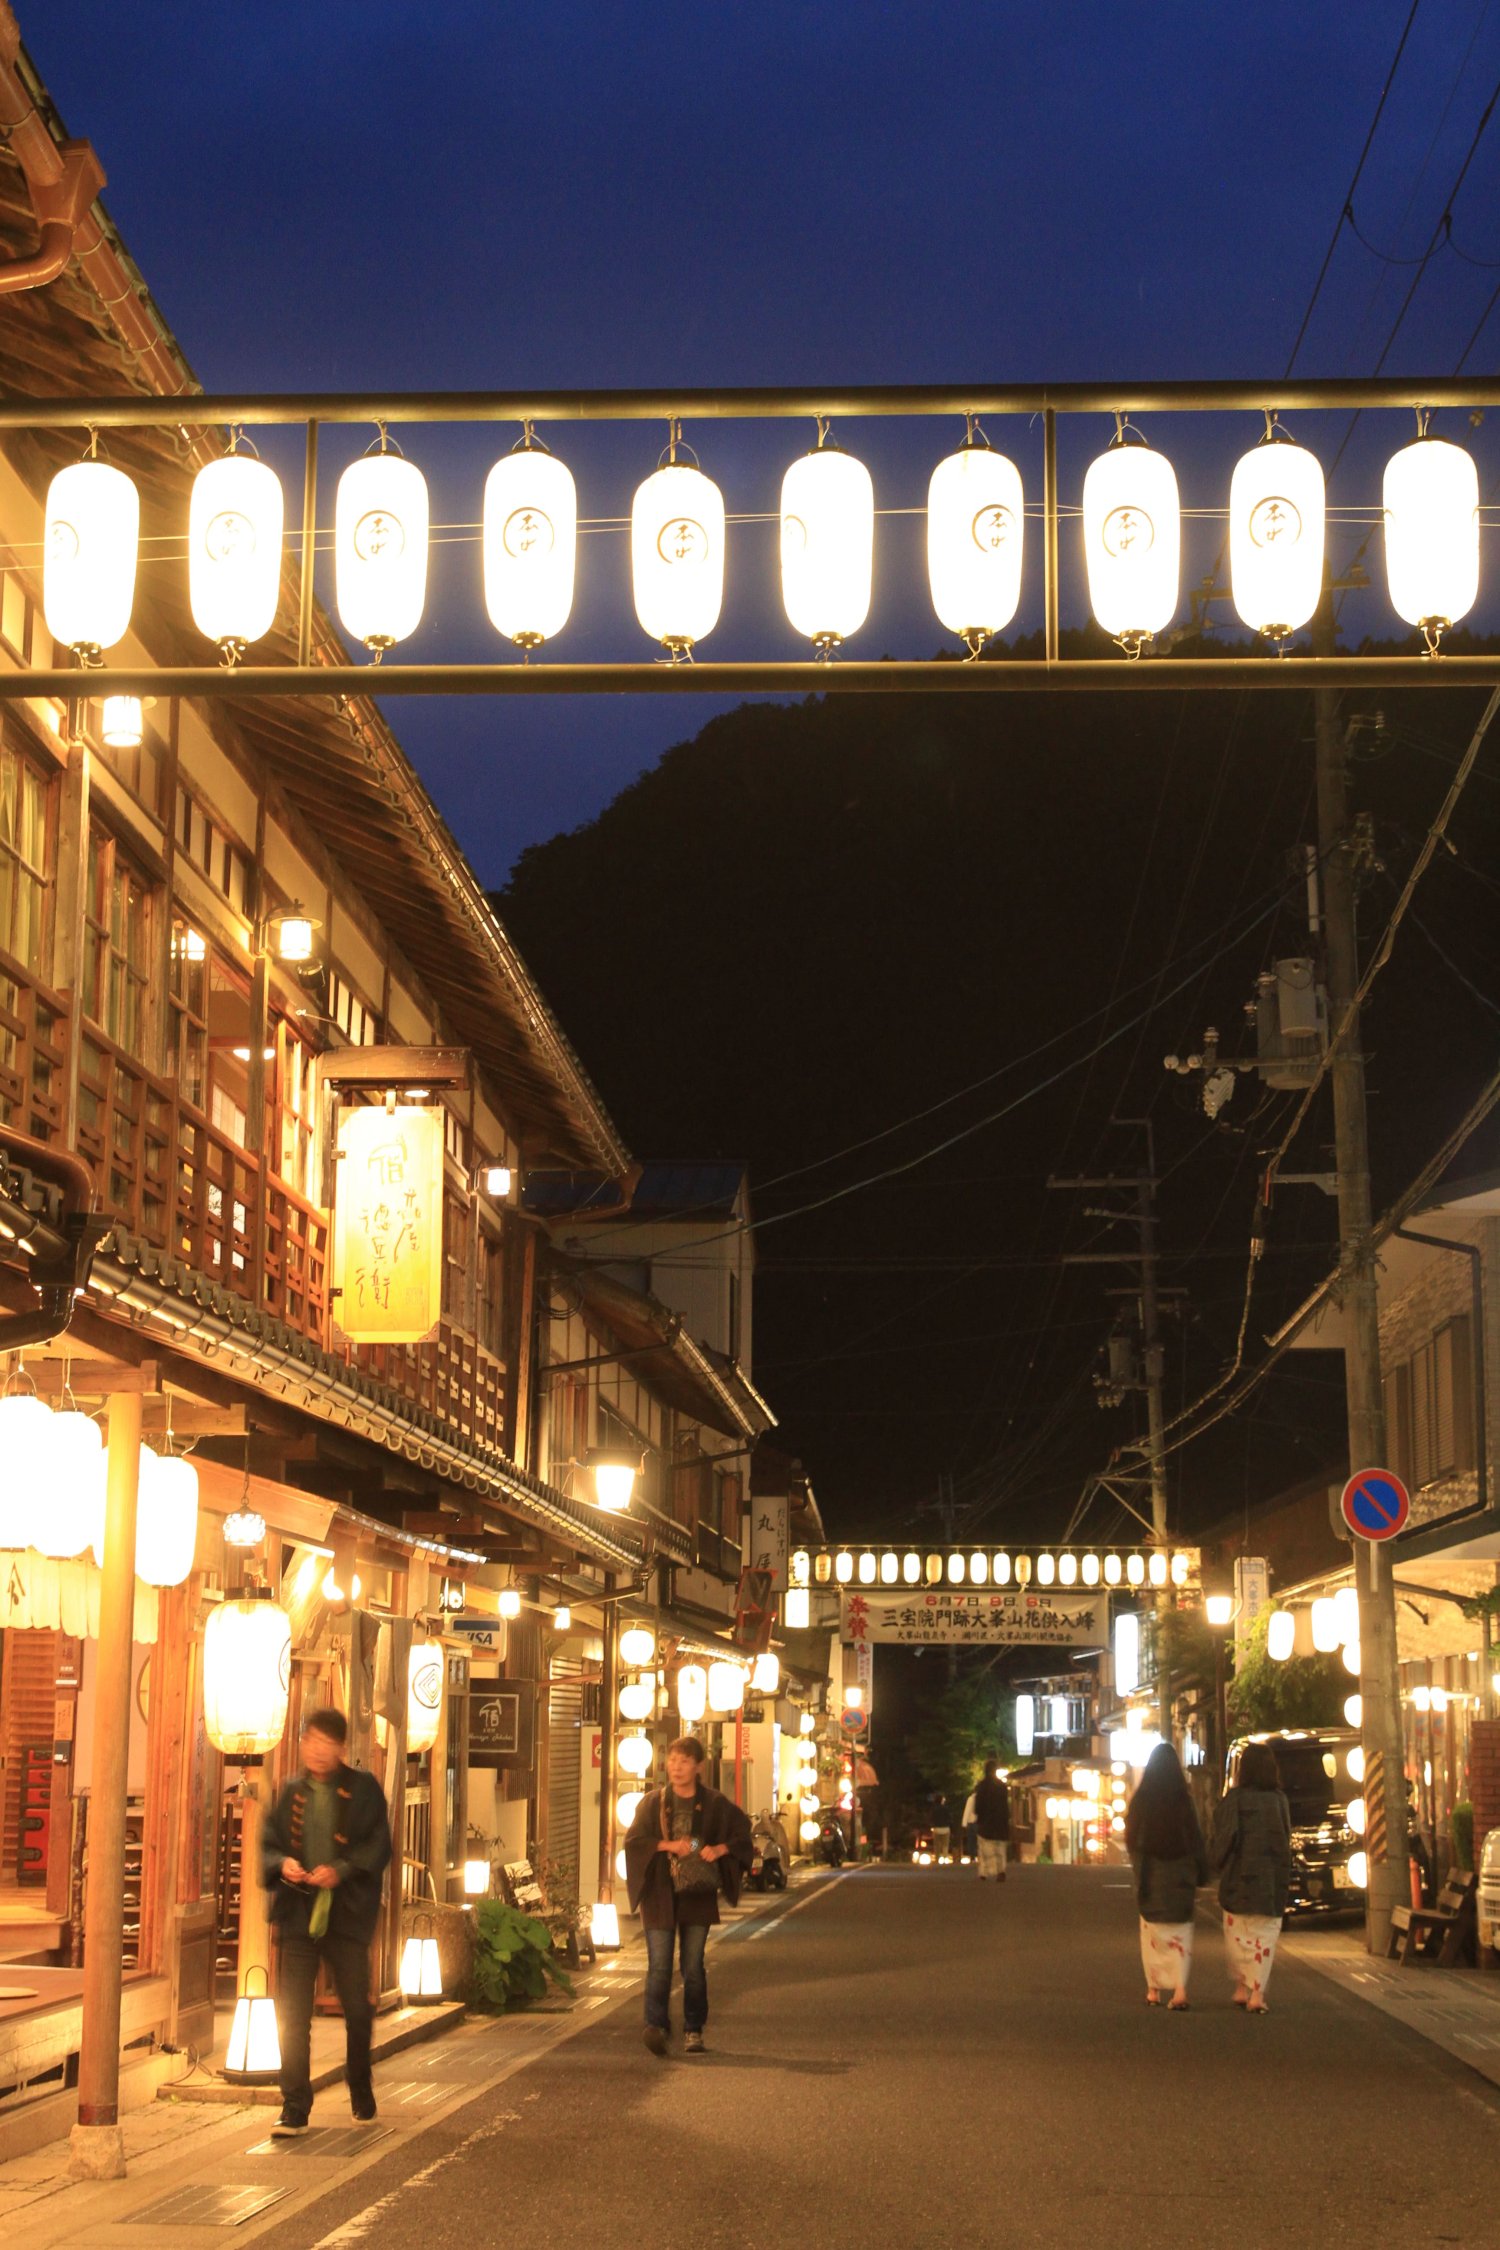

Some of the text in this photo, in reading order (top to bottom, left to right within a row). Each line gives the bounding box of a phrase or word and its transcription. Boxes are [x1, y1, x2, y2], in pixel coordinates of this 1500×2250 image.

[367, 1135, 408, 1185] 宿
[755, 1513, 775, 1569] 丸屋
[479, 1698, 502, 1728] 宿
